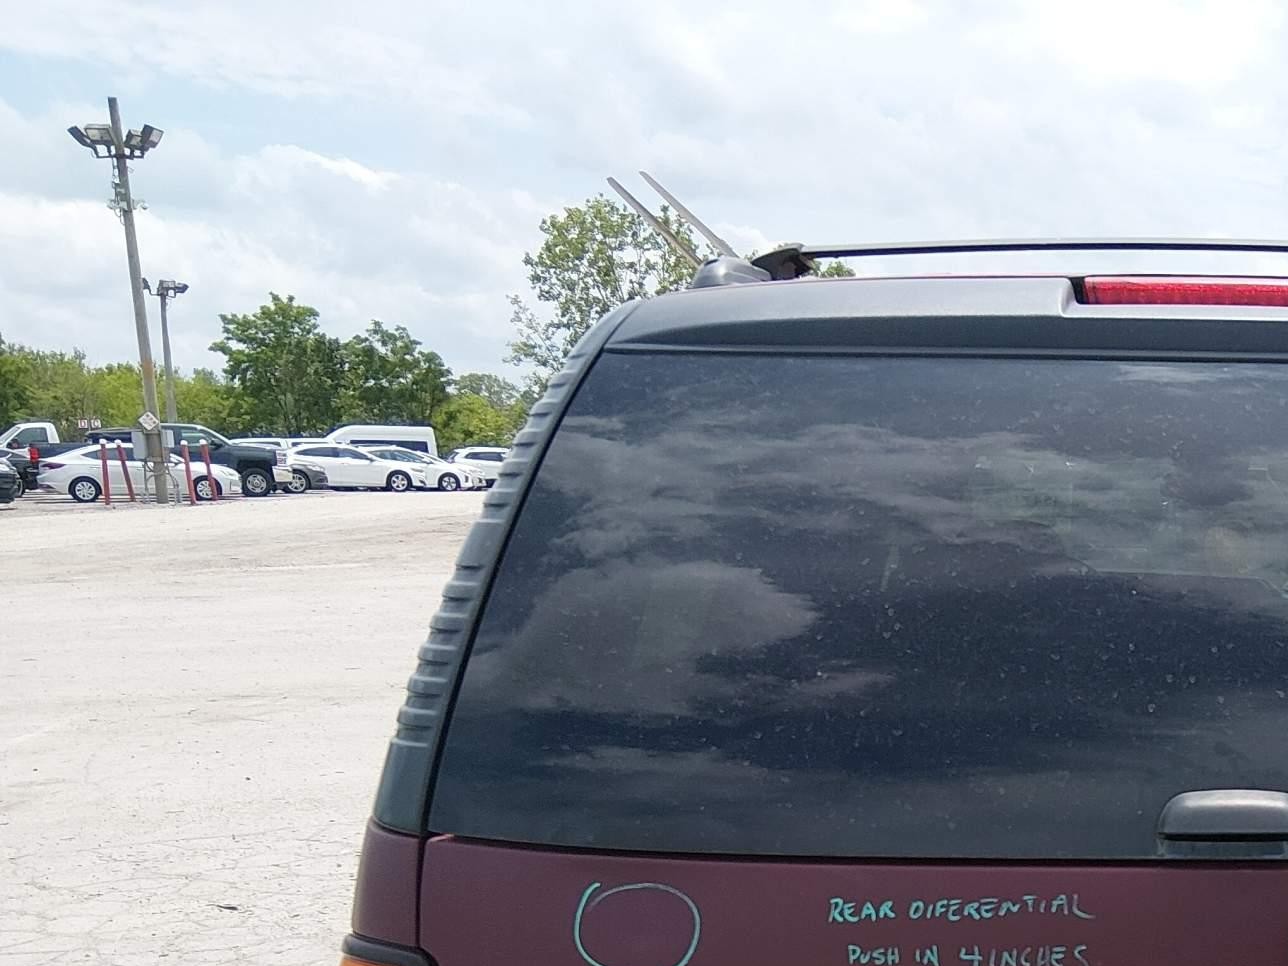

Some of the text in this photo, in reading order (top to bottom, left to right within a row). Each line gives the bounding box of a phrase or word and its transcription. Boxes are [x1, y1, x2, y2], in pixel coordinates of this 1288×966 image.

[828, 893, 1096, 923] REAR DIFERENTIAL
[847, 944, 900, 966] PUSH
